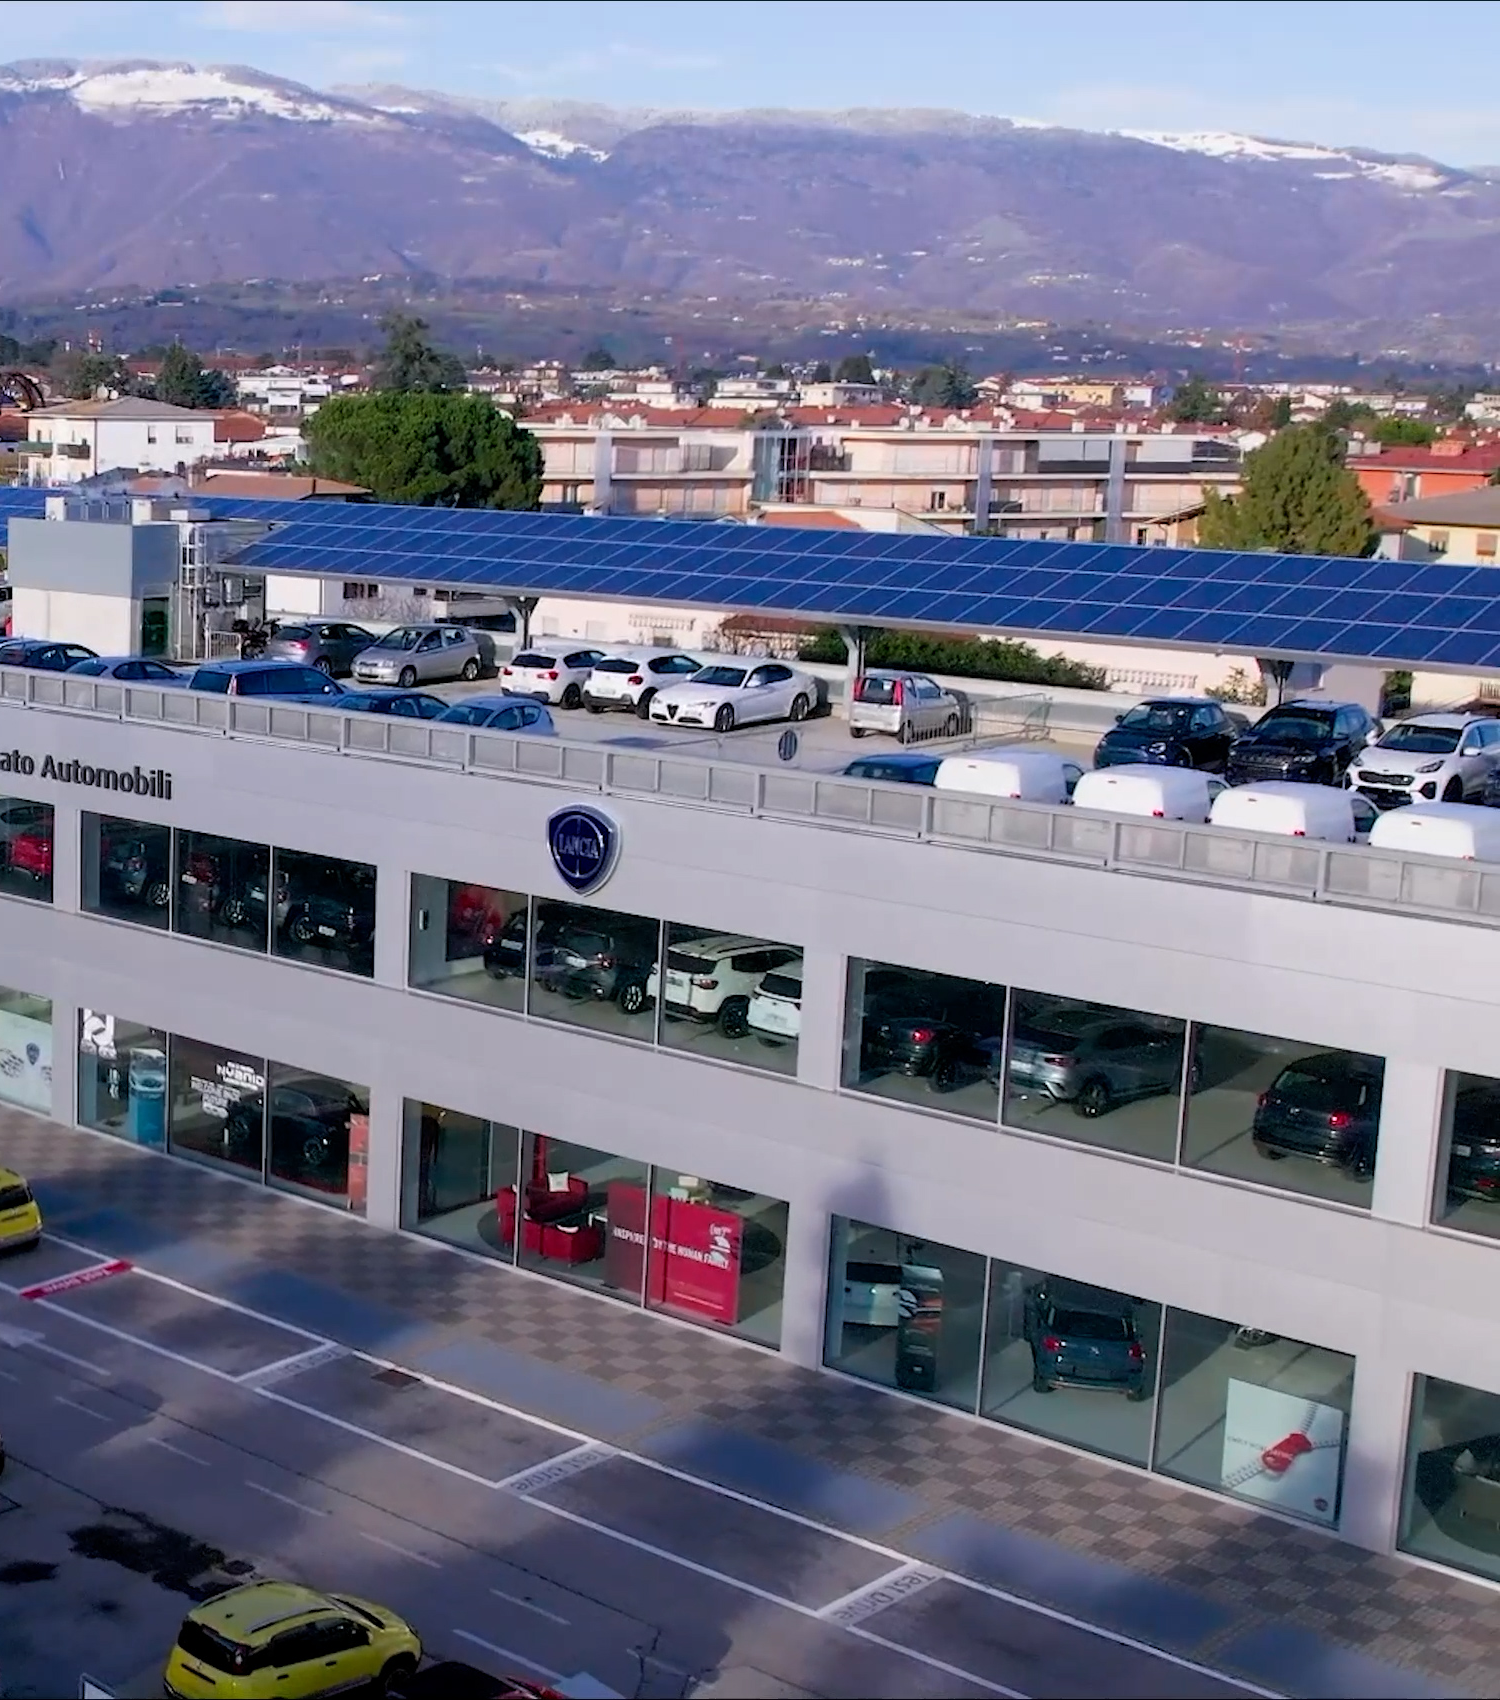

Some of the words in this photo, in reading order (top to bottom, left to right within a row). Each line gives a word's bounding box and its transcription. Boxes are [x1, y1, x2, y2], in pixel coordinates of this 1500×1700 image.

[41, 754, 172, 800] Automobili
[559, 833, 600, 859] LANCIA
[884, 1571, 936, 1594] Test
